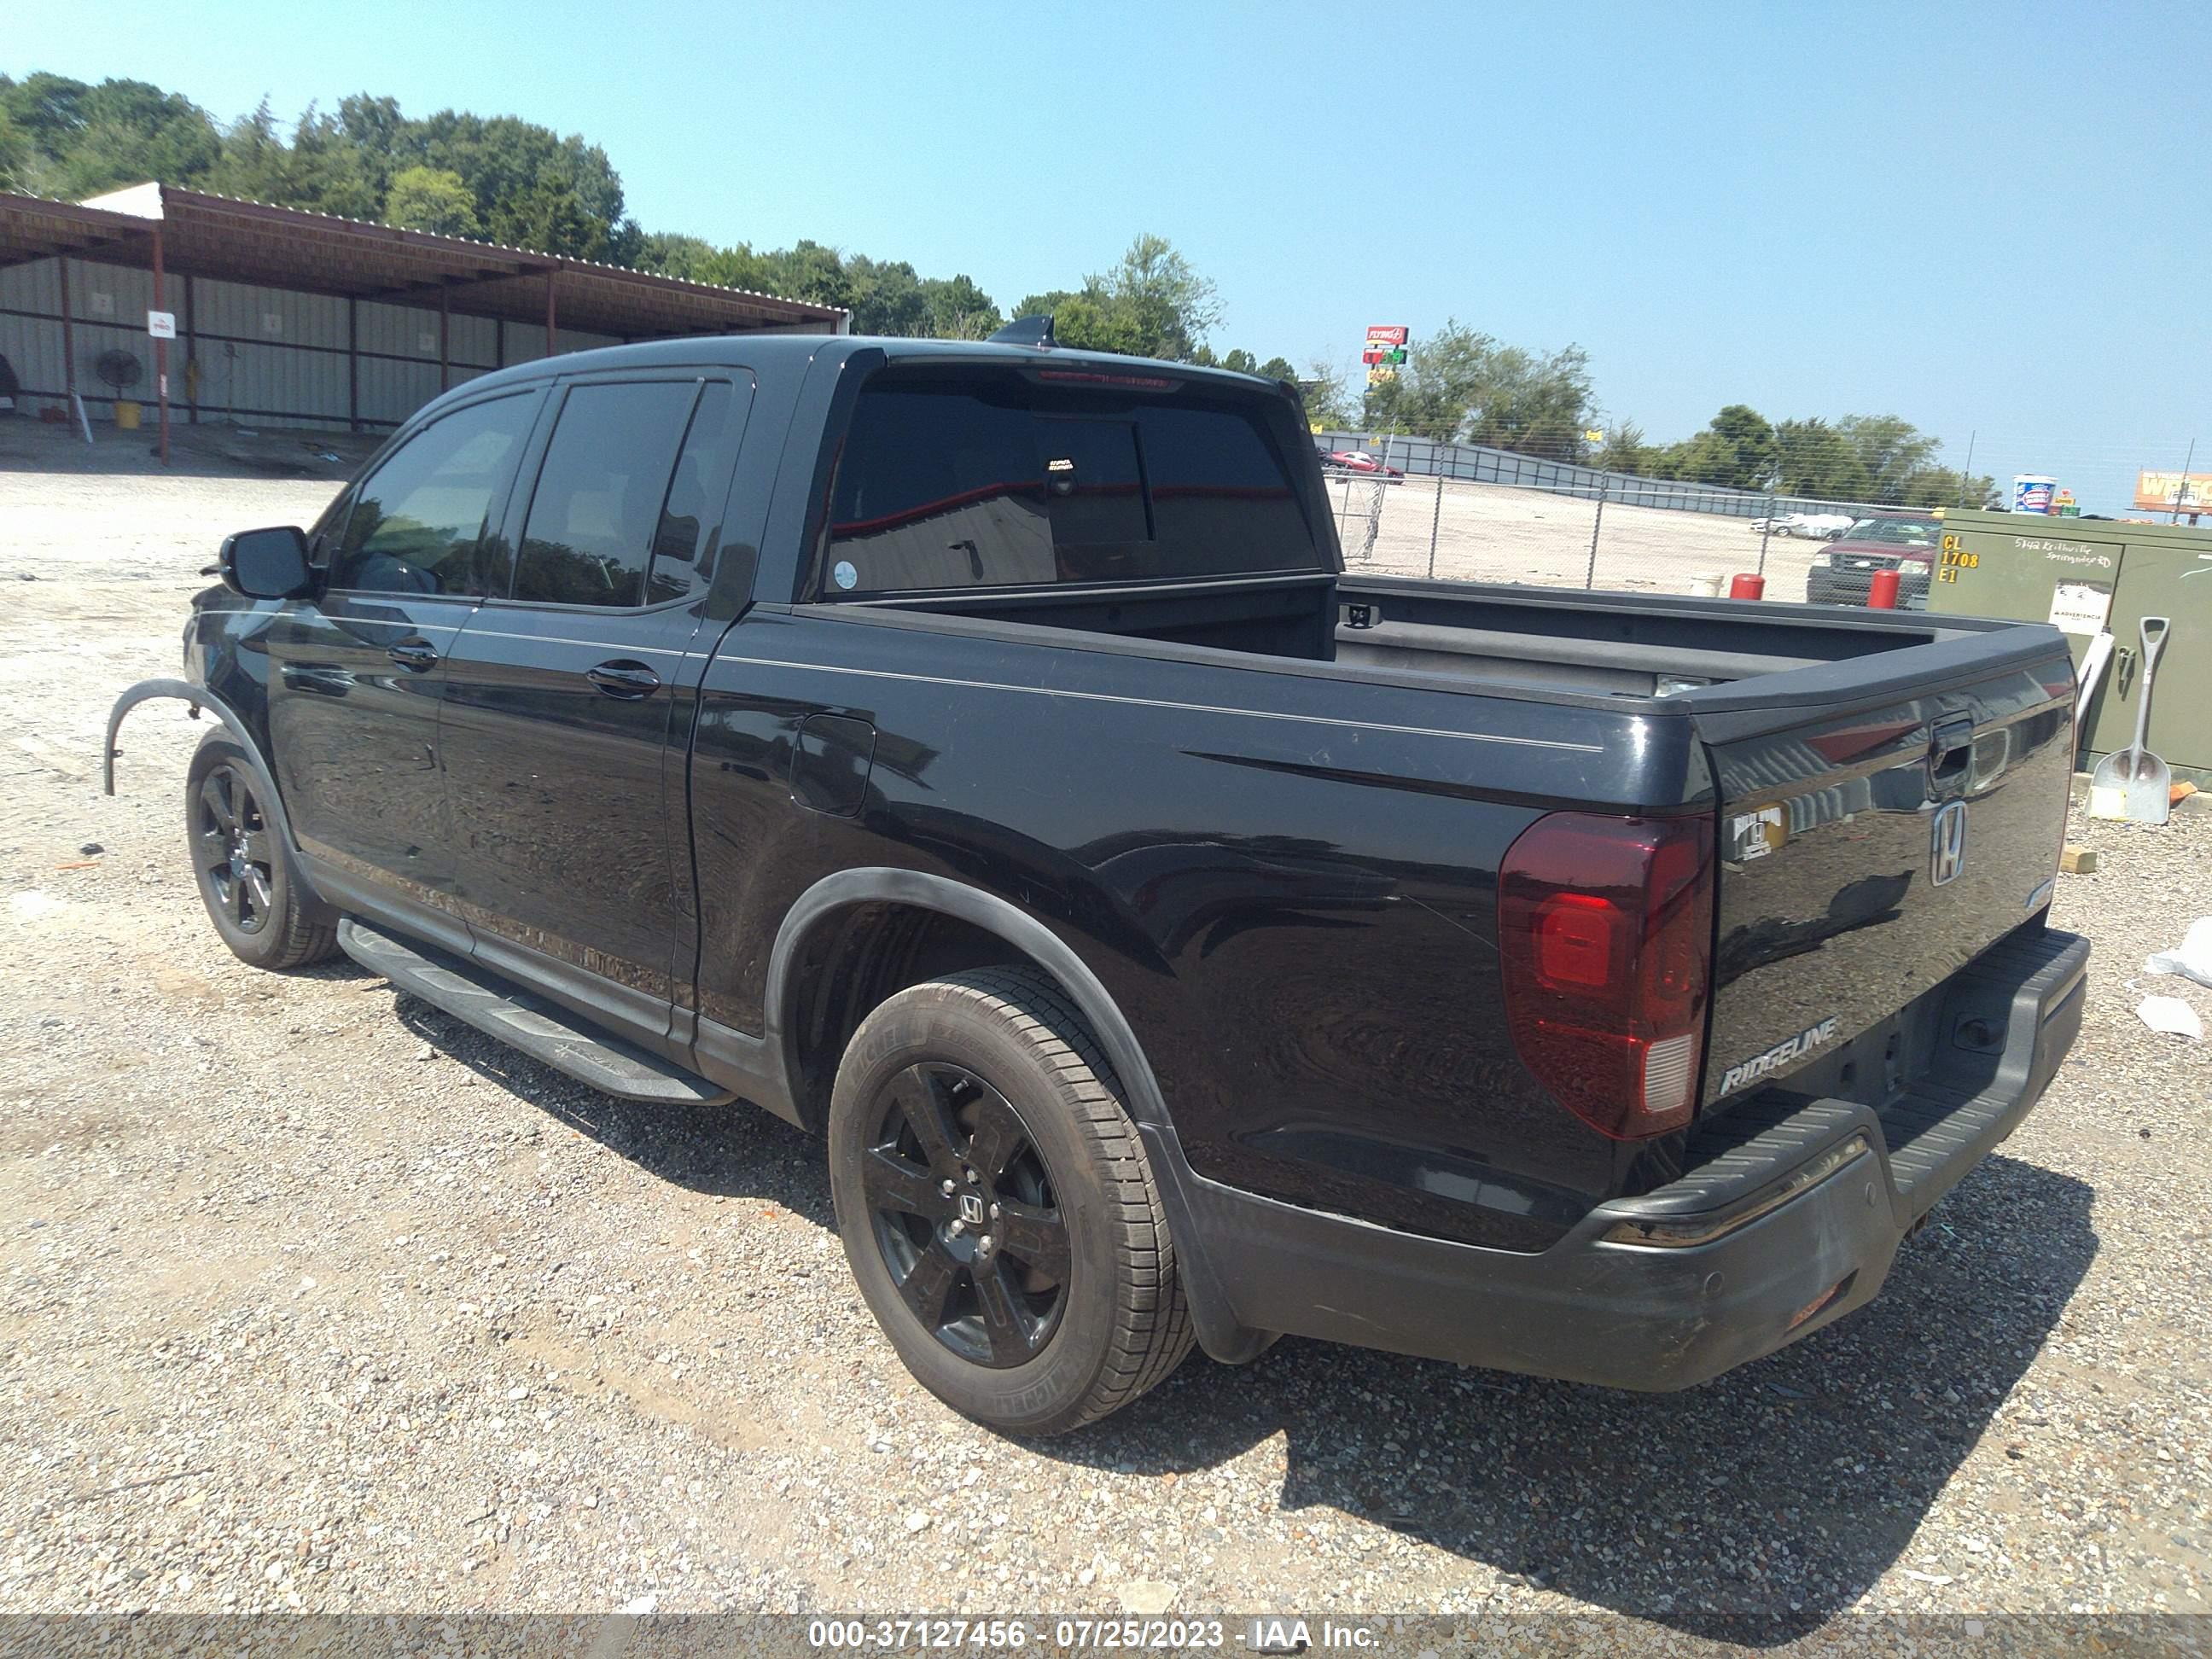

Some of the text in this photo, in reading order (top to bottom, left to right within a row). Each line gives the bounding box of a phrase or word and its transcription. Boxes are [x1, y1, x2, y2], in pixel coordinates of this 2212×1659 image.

[1368, 330, 1394, 339] FLYING
[1944, 535, 1962, 550] CL
[1941, 550, 1979, 568] 1708
[1938, 568, 1956, 583] E1
[1720, 1016, 1839, 1096] RIDGELINE
